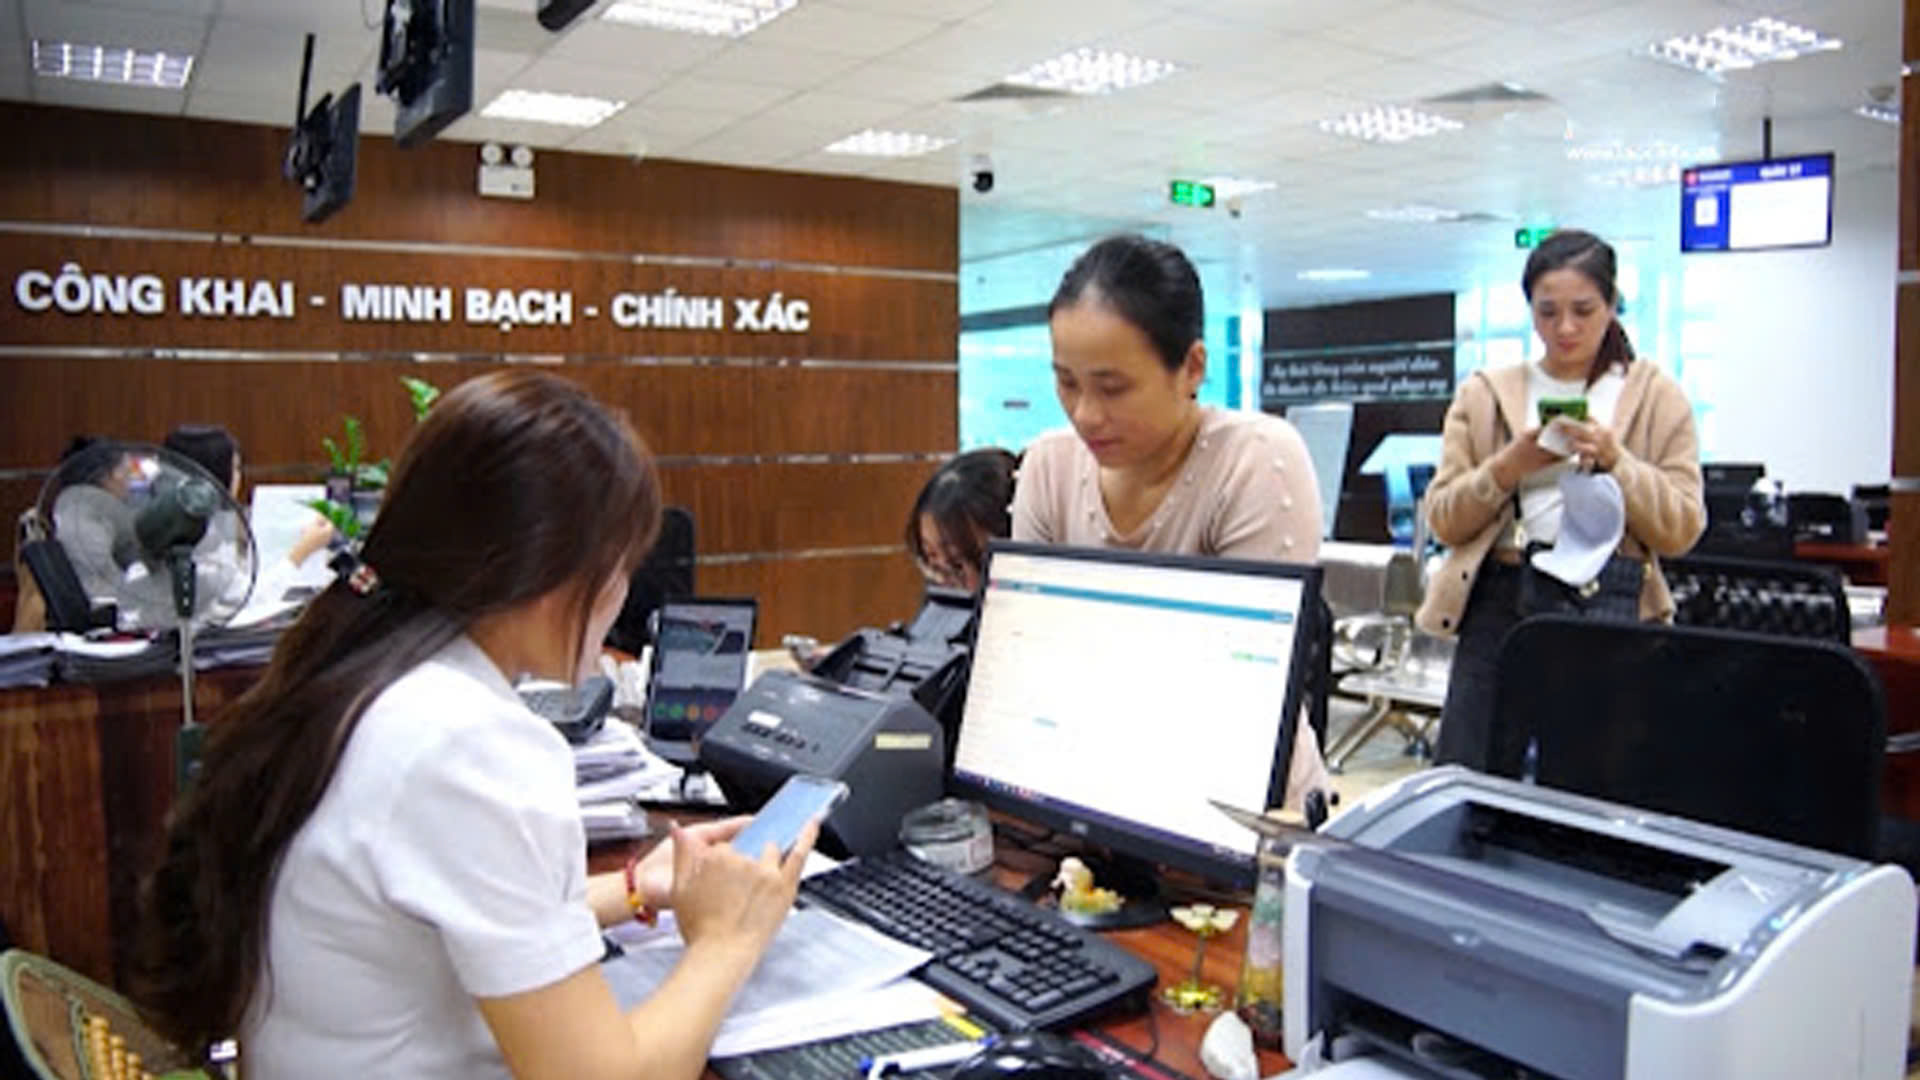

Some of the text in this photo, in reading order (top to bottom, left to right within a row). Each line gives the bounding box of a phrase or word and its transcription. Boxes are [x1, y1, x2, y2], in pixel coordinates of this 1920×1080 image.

[16, 263, 165, 314] CÔNG
[180, 277, 295, 317] KHAI
[342, 284, 452, 321] MINH
[465, 288, 572, 332] BẠCH
[611, 288, 724, 328] CHÍNH
[734, 292, 810, 332] XÁC
